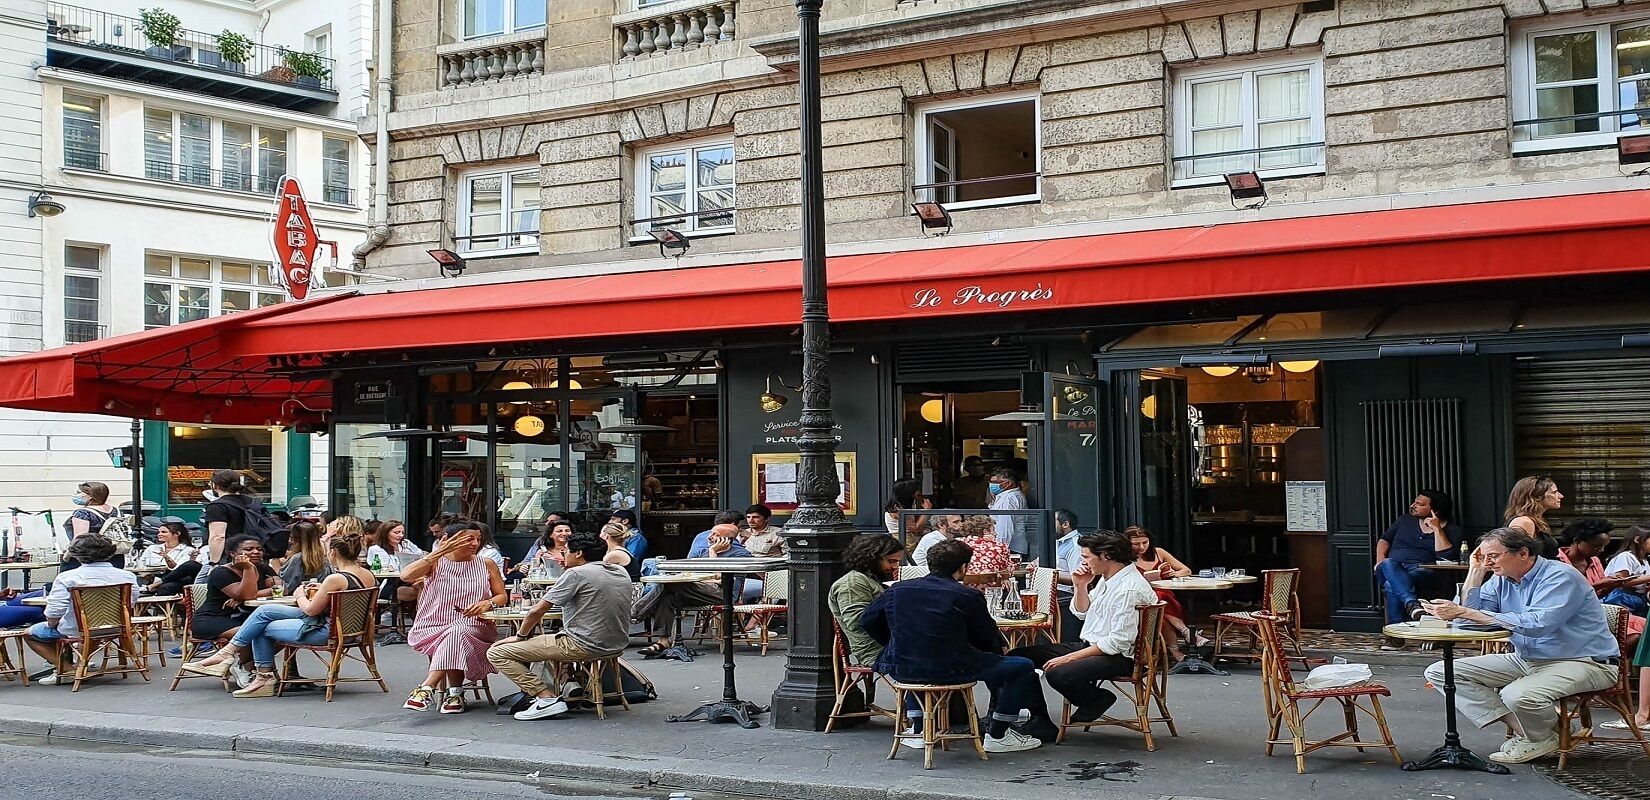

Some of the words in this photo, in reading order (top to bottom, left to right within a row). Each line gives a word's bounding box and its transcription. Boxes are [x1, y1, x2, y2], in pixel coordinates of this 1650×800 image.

[285, 193, 309, 284] TABAC
[910, 288, 942, 308] Le
[952, 282, 1053, 307] Progrès
[1067, 407, 1080, 417] Le
[763, 420, 800, 433] Service
